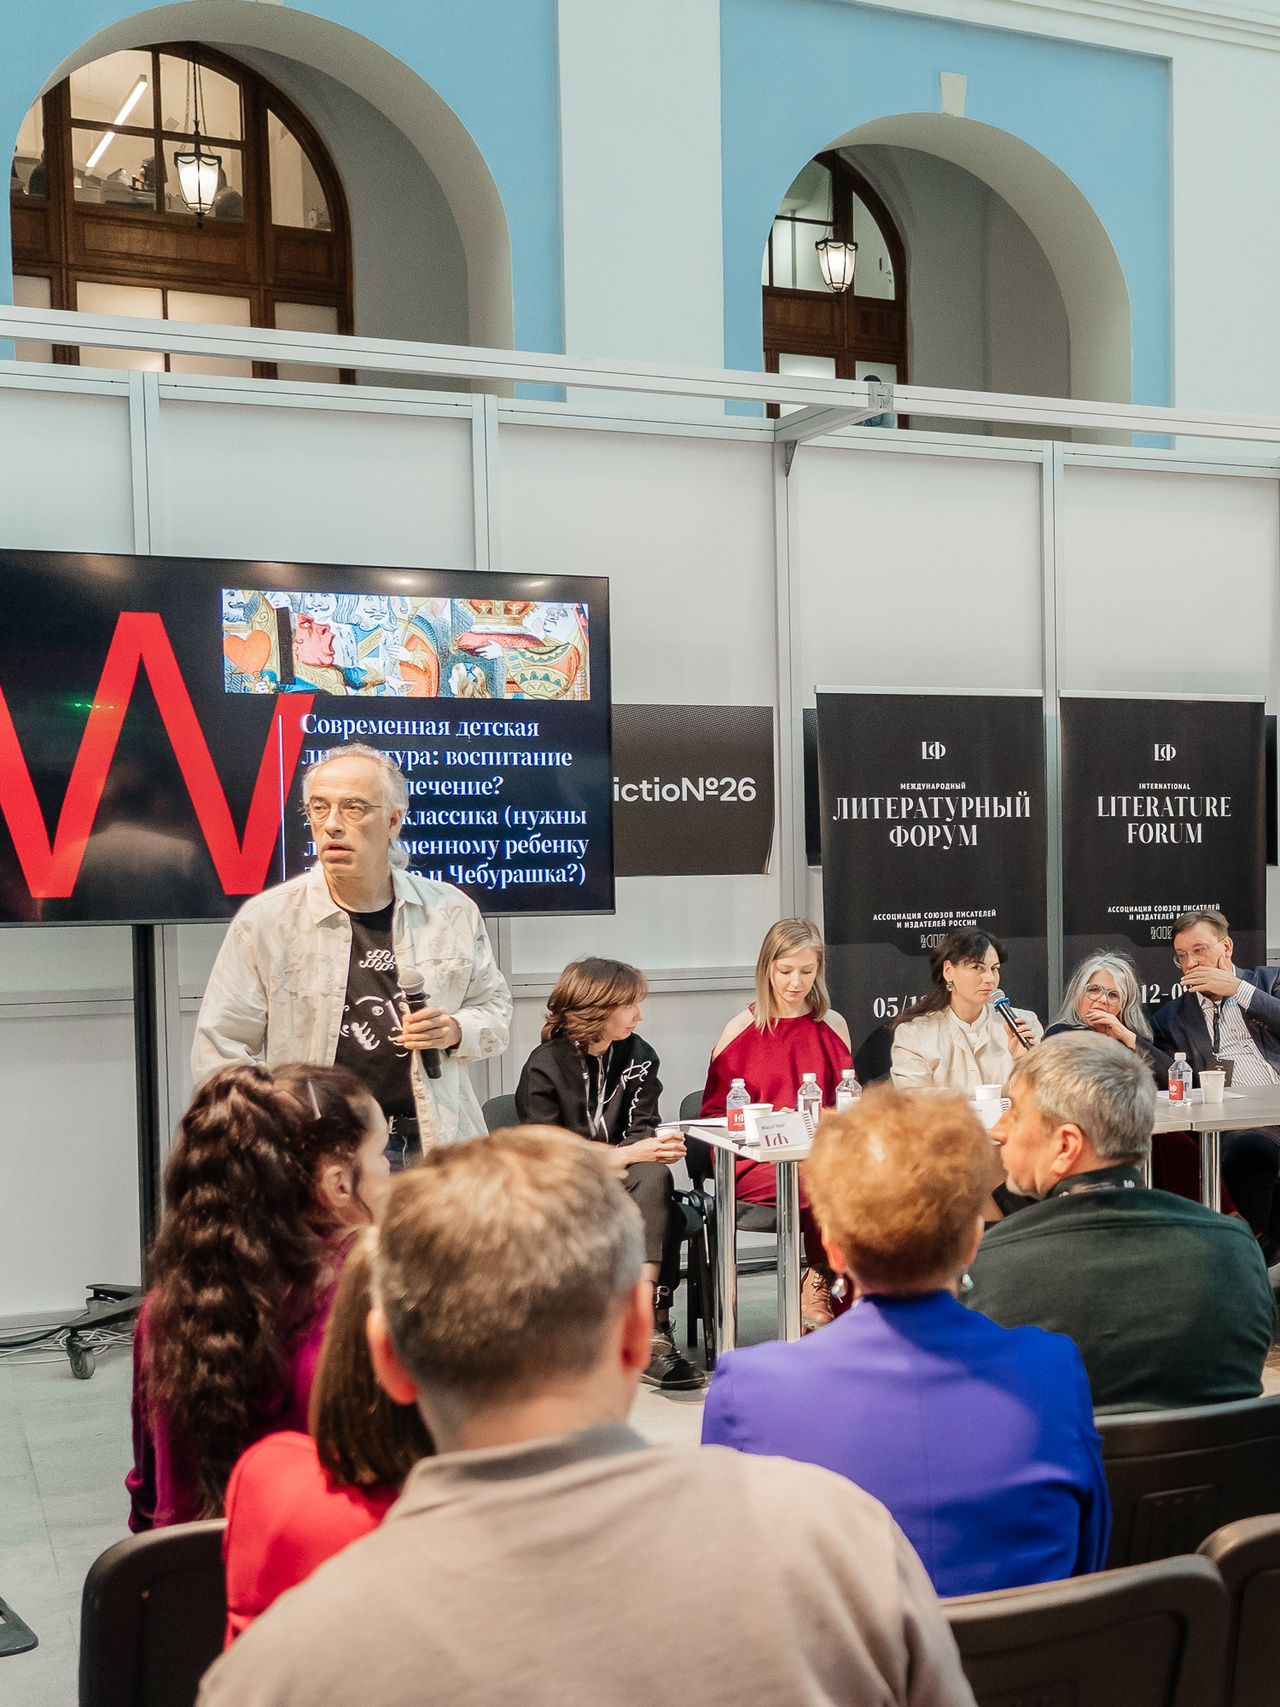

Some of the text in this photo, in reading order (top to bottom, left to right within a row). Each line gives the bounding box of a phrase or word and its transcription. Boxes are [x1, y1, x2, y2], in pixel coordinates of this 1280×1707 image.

[301, 713, 539, 740] Современная детская
[447, 750, 573, 766] воспитание
[613, 777, 757, 802] ictio№26
[900, 782, 966, 791] МЕЖДУНАРОДНЫЙ
[1138, 782, 1191, 790] INTERNATIONAL
[832, 790, 1031, 822] ЛИТЕРАТУРНЫЙ
[1097, 795, 1232, 818] LITERATURE
[401, 805, 587, 830] классика (нужны
[889, 824, 978, 850] ФОРУМ
[1127, 822, 1203, 844] FORUM
[505, 832, 589, 860] ребенку
[448, 862, 586, 889] Чебурашка?)
[873, 909, 997, 921] АССОЦИАЦИЯ СОЮЗОВ ПИСАТЕЛЕЙ
[1107, 905, 1152, 913] АССОЦИАЦИЯ
[1154, 904, 1181, 912] СОЮЗОВ
[1136, 912, 1174, 921] ИЗДАТЕЛЕЙ
[904, 920, 946, 929] ИЗДАТЕЛЕЙ
[948, 919, 977, 927] РОССИИ
